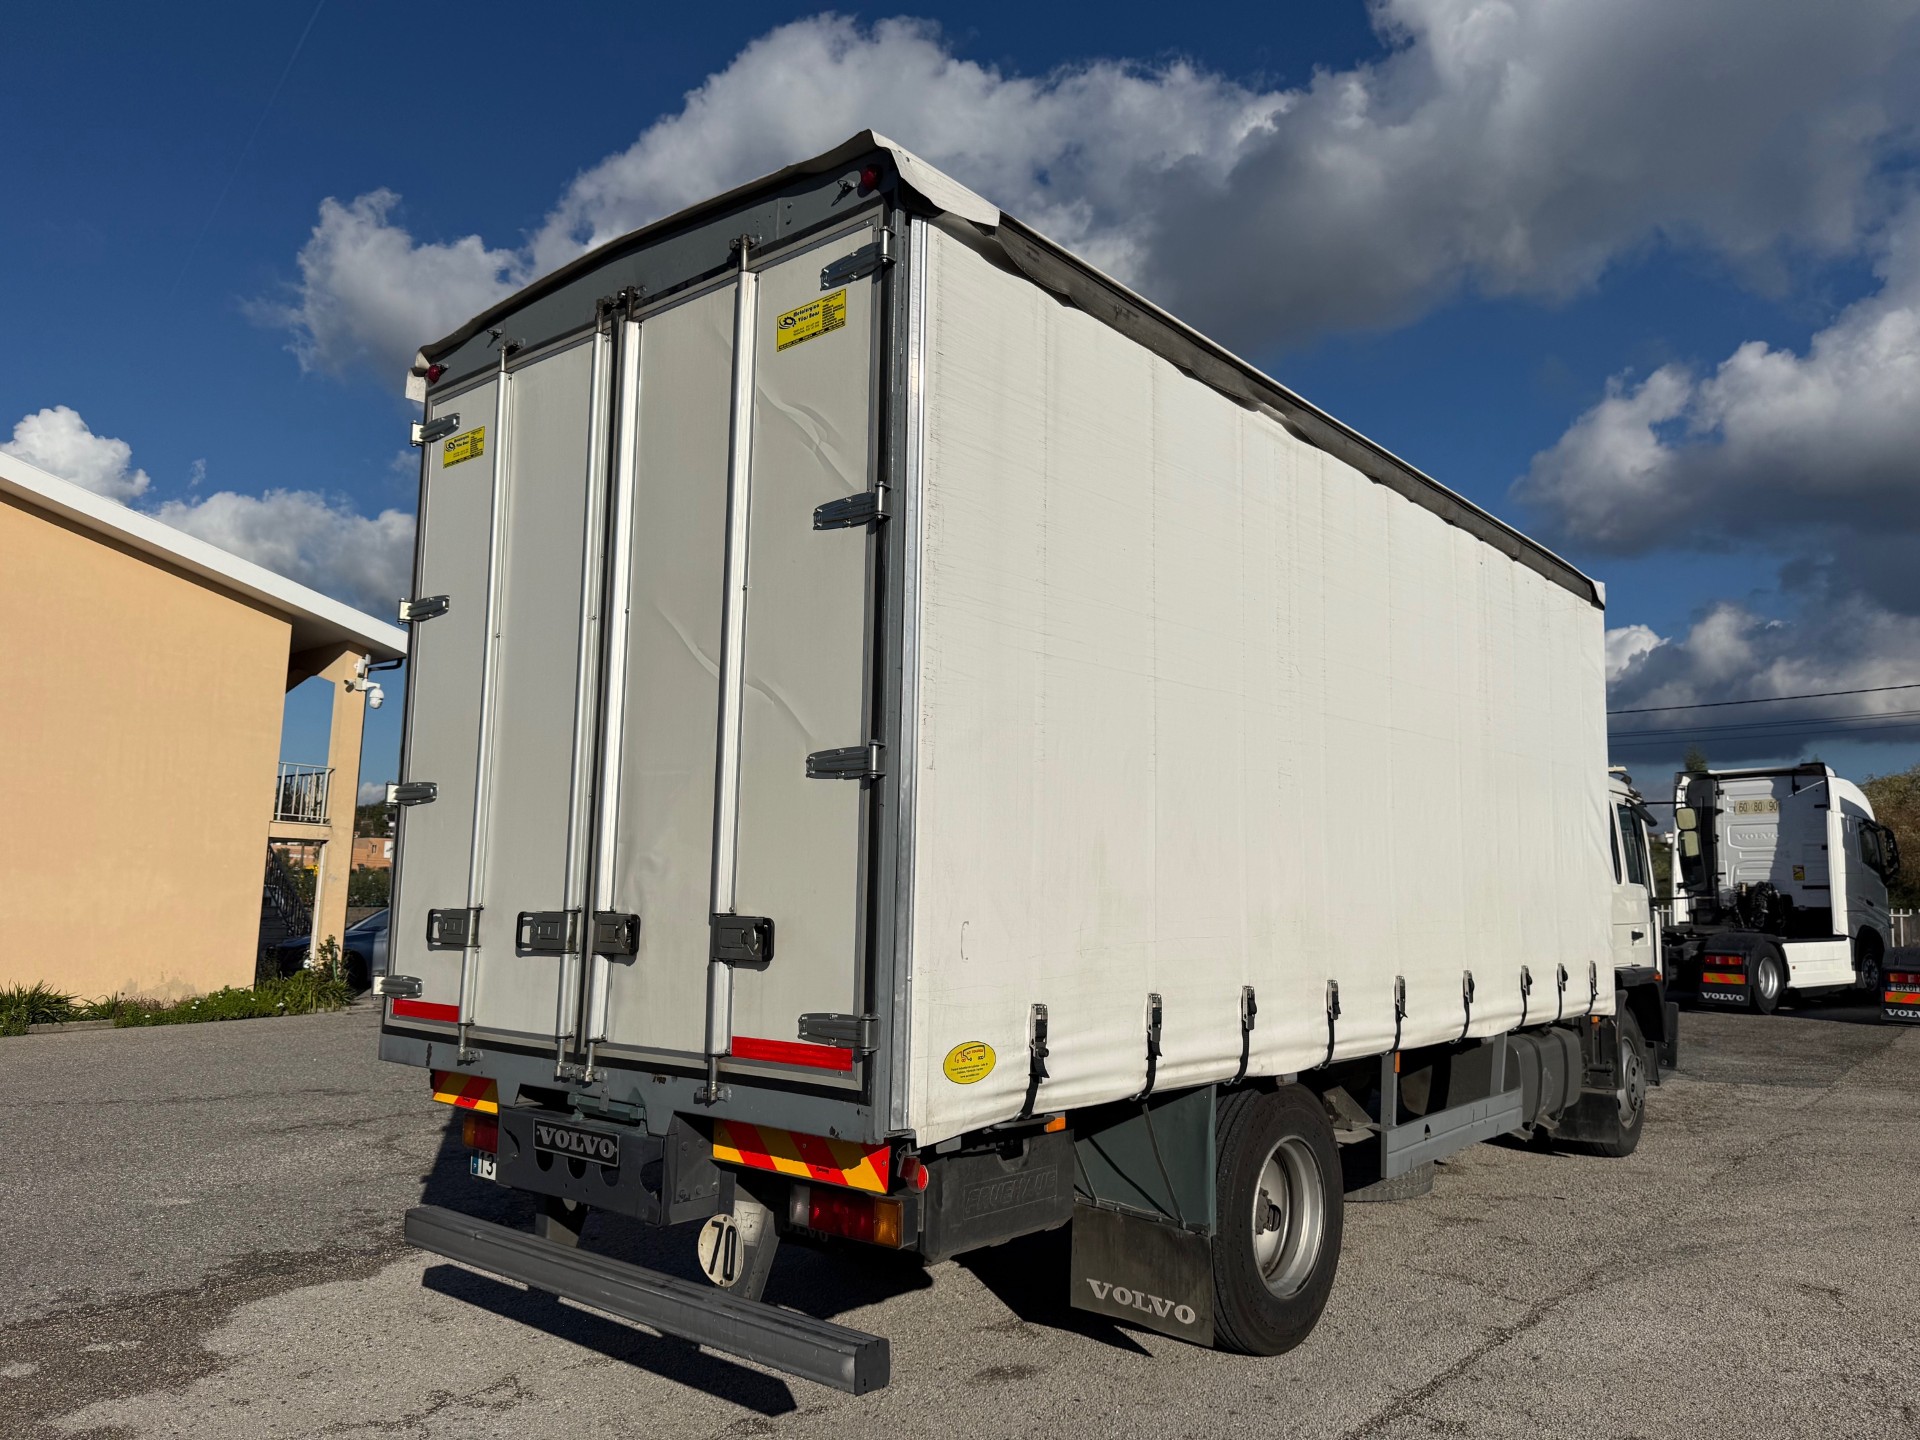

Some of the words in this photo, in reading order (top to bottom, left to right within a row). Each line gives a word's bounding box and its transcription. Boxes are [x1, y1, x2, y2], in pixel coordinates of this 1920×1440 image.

[1738, 803, 1747, 812] 60
[1753, 802, 1763, 812] 80
[1768, 801, 1778, 811] 90
[1701, 991, 1745, 1002] VOLVO
[537, 1125, 615, 1158] VOLVO
[708, 1220, 737, 1282] 70
[1086, 1278, 1196, 1325] VOLVO
